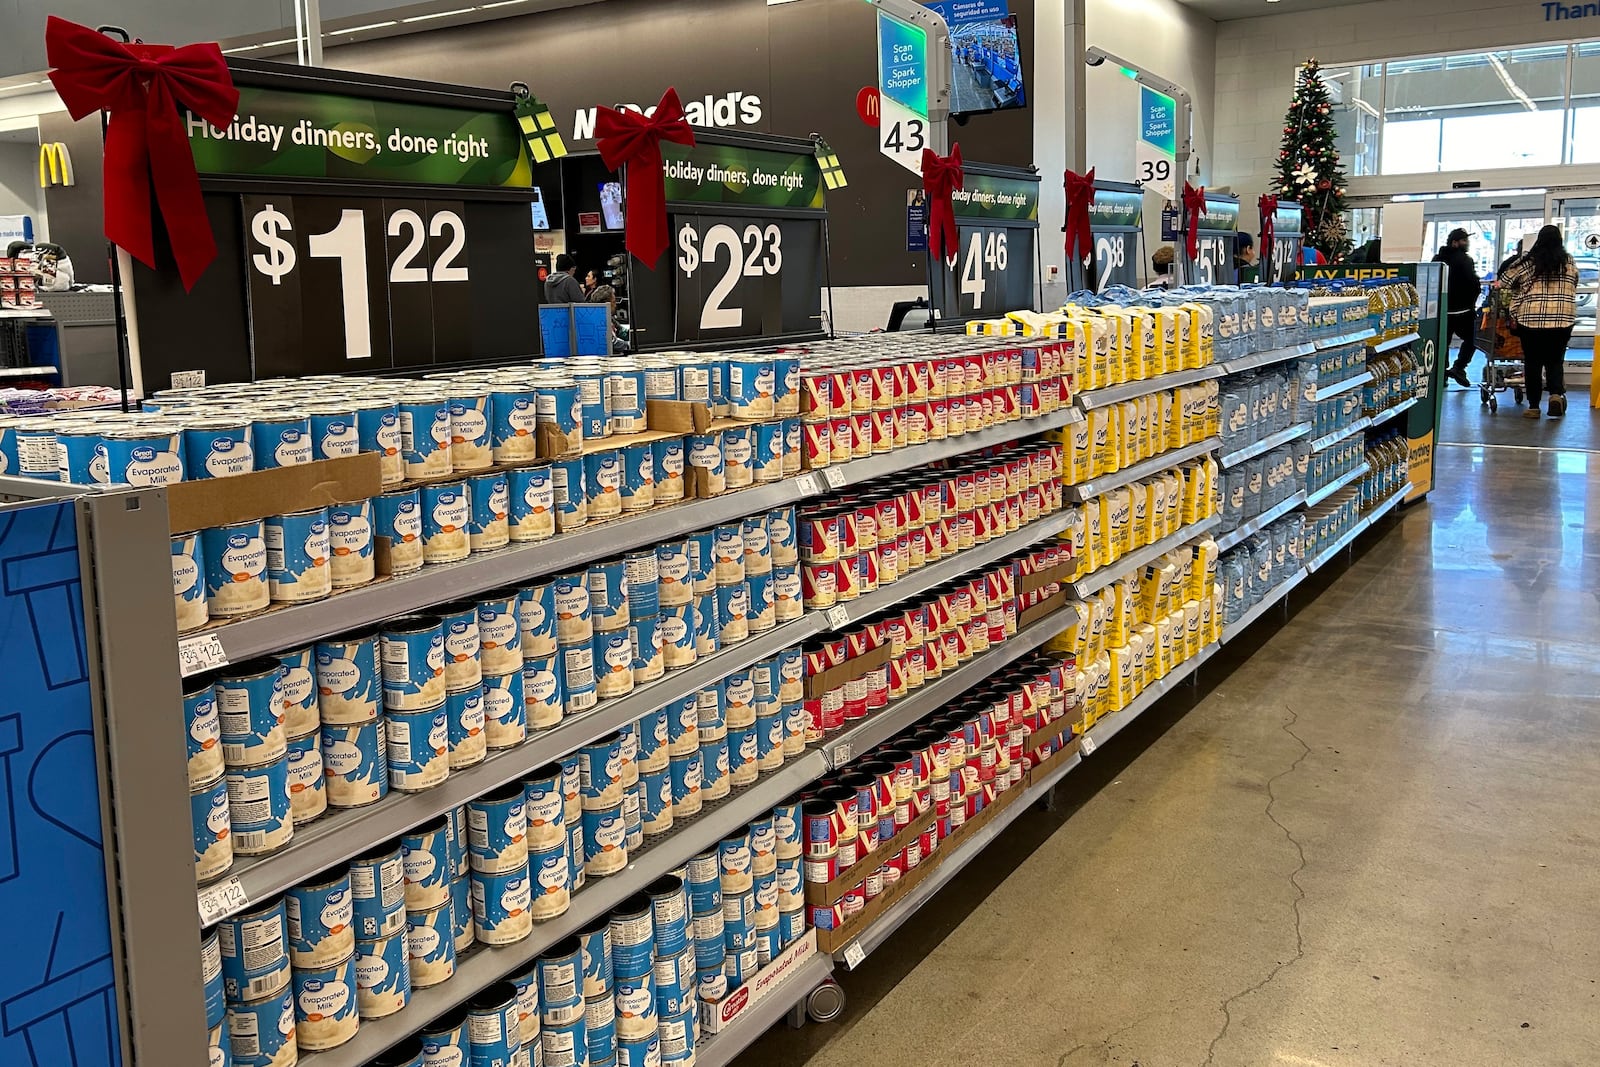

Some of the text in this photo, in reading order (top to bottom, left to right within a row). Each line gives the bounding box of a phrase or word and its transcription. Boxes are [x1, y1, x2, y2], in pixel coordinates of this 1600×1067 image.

[953, 8, 981, 18] seguridad
[893, 44, 913, 54] Scan
[893, 52, 913, 63] & Go
[892, 67, 915, 79] Spark
[887, 77, 921, 88] Shopper
[1149, 122, 1167, 130] Spark
[884, 119, 924, 153] 43
[1145, 129, 1171, 137] Shopper
[291, 119, 381, 154] dinners,
[387, 128, 437, 154] done
[443, 133, 488, 162] right
[1141, 160, 1170, 182] 39
[706, 163, 750, 187] dinners,
[752, 168, 778, 186] done
[779, 171, 804, 192] right
[972, 188, 997, 206] dinners,
[997, 191, 1012, 206] done
[1012, 193, 1027, 209] right
[459, 425, 474, 434] Milk
[213, 439, 232, 448] Great
[133, 449, 153, 458] Great
[132, 463, 180, 477] Evaporated
[228, 464, 244, 473] Milk
[150, 475, 167, 485] Milk
[331, 513, 348, 522] Great
[330, 526, 369, 539] Evaporated
[229, 535, 249, 546] Great
[344, 536, 359, 546] Milk
[243, 559, 258, 569] Milk
[173, 566, 195, 577] rated
[567, 602, 580, 611] Milk
[520, 608, 542, 617] orated
[452, 623, 466, 632] Great
[491, 630, 506, 640] Milk
[462, 643, 475, 651] Milk
[283, 676, 311, 691] porated
[326, 677, 342, 686] Milk
[284, 687, 301, 698] Milk
[531, 686, 545, 695] Milk
[484, 695, 510, 706] porated
[329, 759, 344, 768] Milk
[299, 771, 313, 781] Milk
[403, 857, 433, 869] porated
[404, 866, 420, 876] Milk
[328, 891, 342, 903] Great
[407, 933, 436, 945] porated
[408, 941, 424, 951] Milk
[793, 941, 810, 961] Milk
[355, 963, 384, 974] porated
[305, 980, 321, 990] Great
[303, 987, 346, 1004] Evaporated
[317, 1001, 333, 1010] Milk
